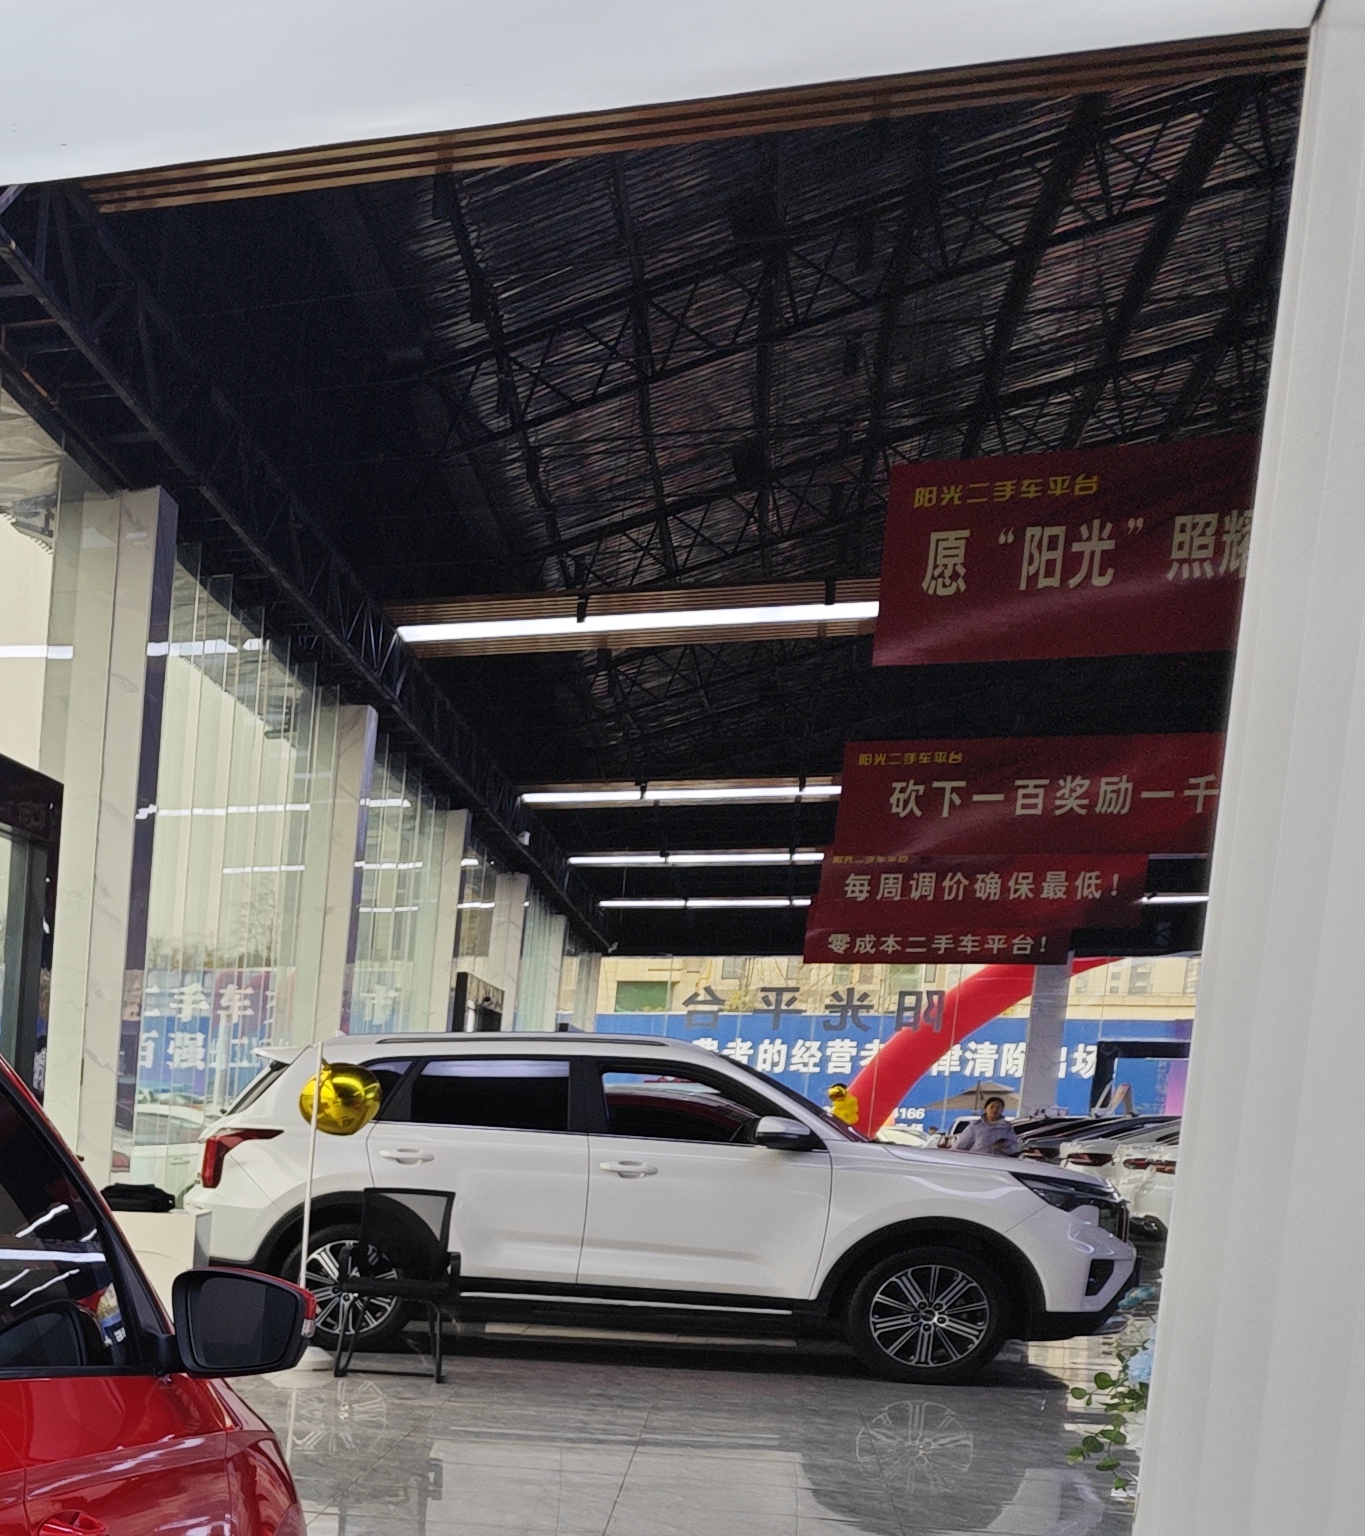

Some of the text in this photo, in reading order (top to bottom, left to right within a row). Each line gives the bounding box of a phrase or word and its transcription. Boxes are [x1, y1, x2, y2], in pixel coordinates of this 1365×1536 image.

[914, 473, 1099, 508] 阳光二手车平台
[858, 751, 963, 766] 阳光二手车平台
[889, 774, 1220, 818] 砍下一百奖励一千
